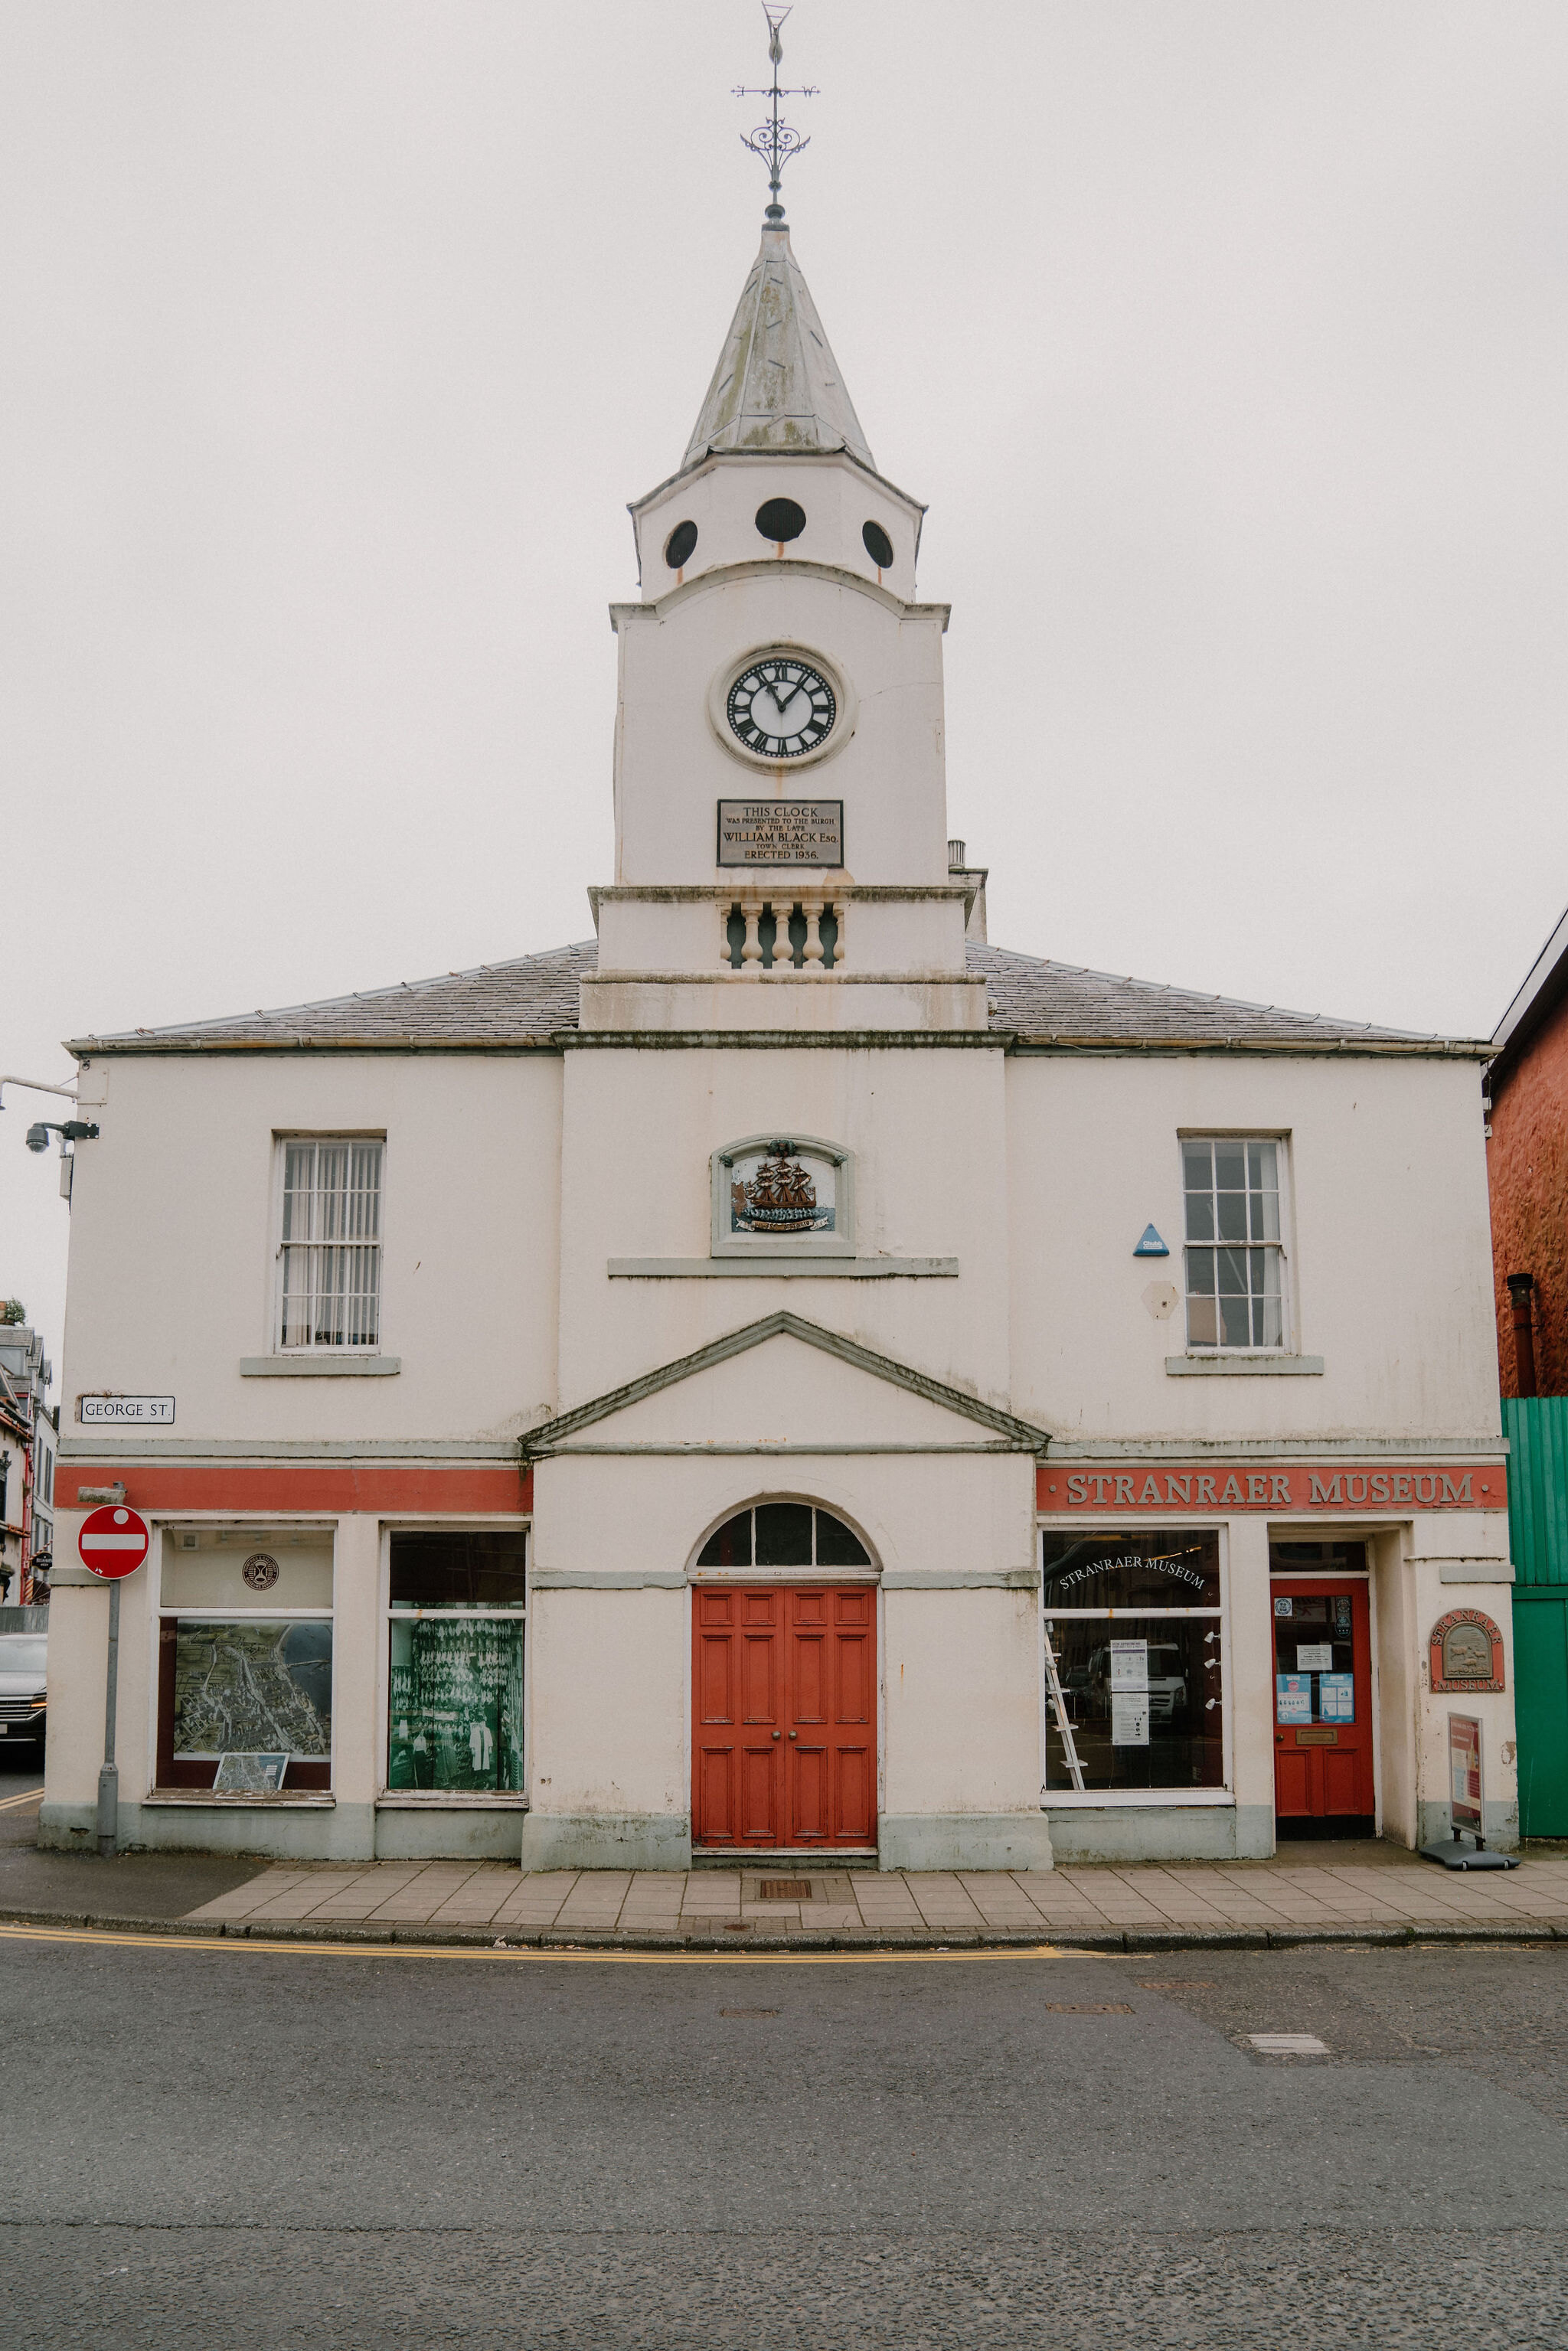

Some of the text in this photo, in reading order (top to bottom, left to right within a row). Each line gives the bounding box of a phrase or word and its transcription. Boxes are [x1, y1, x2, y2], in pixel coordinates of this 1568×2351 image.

[743, 807, 818, 817] THIS CLOCK
[723, 832, 774, 842] WILLIAM
[778, 832, 817, 842] BLACK
[744, 851, 819, 860] ERECTED 1936.
[85, 1403, 171, 1415] GEORGE ST.
[1067, 1474, 1474, 1504] STRANRAER MUSEUM
[1060, 1556, 1205, 1590] STRANRAER MUSEUM
[1432, 1610, 1501, 1646] STRANRAER
[1437, 1678, 1499, 1691] MUSEUM
